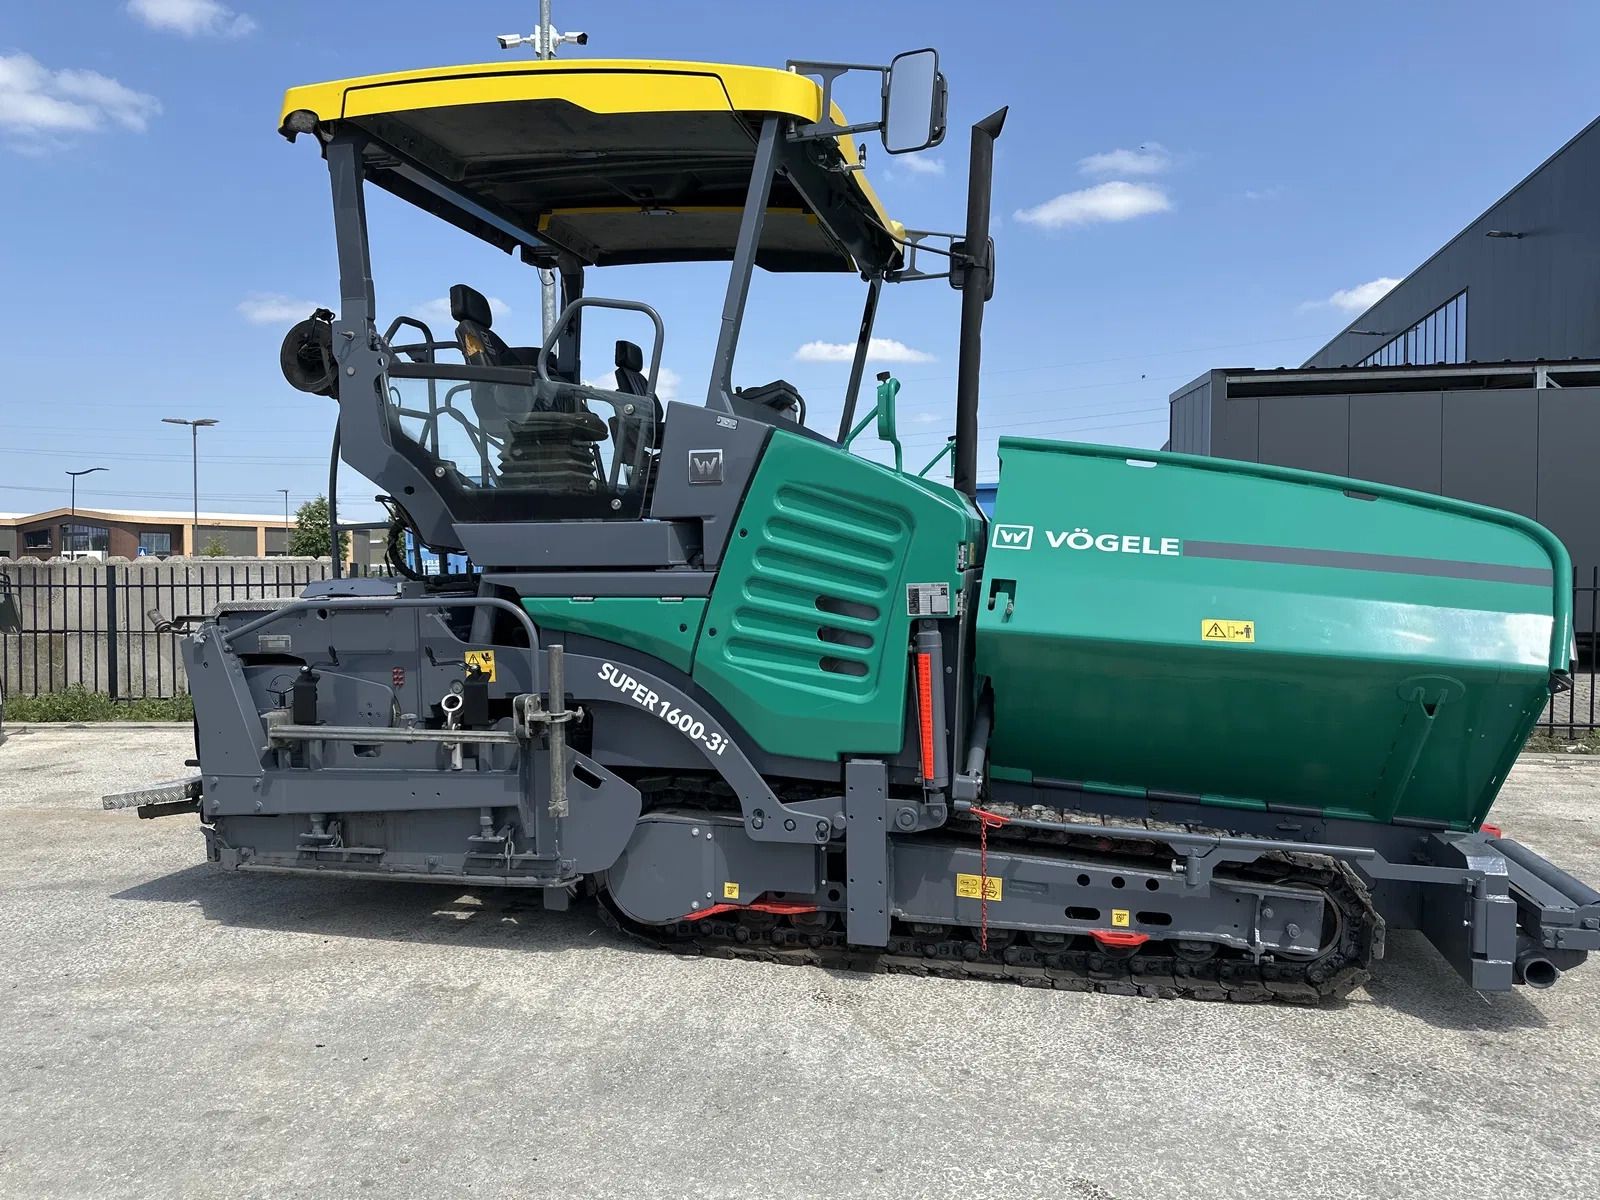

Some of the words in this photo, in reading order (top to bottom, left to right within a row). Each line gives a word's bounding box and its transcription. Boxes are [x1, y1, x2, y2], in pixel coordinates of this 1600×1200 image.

[1045, 527, 1180, 556] VÖGELE
[597, 662, 659, 712] SUPER
[659, 701, 729, 756] 1600-3i
